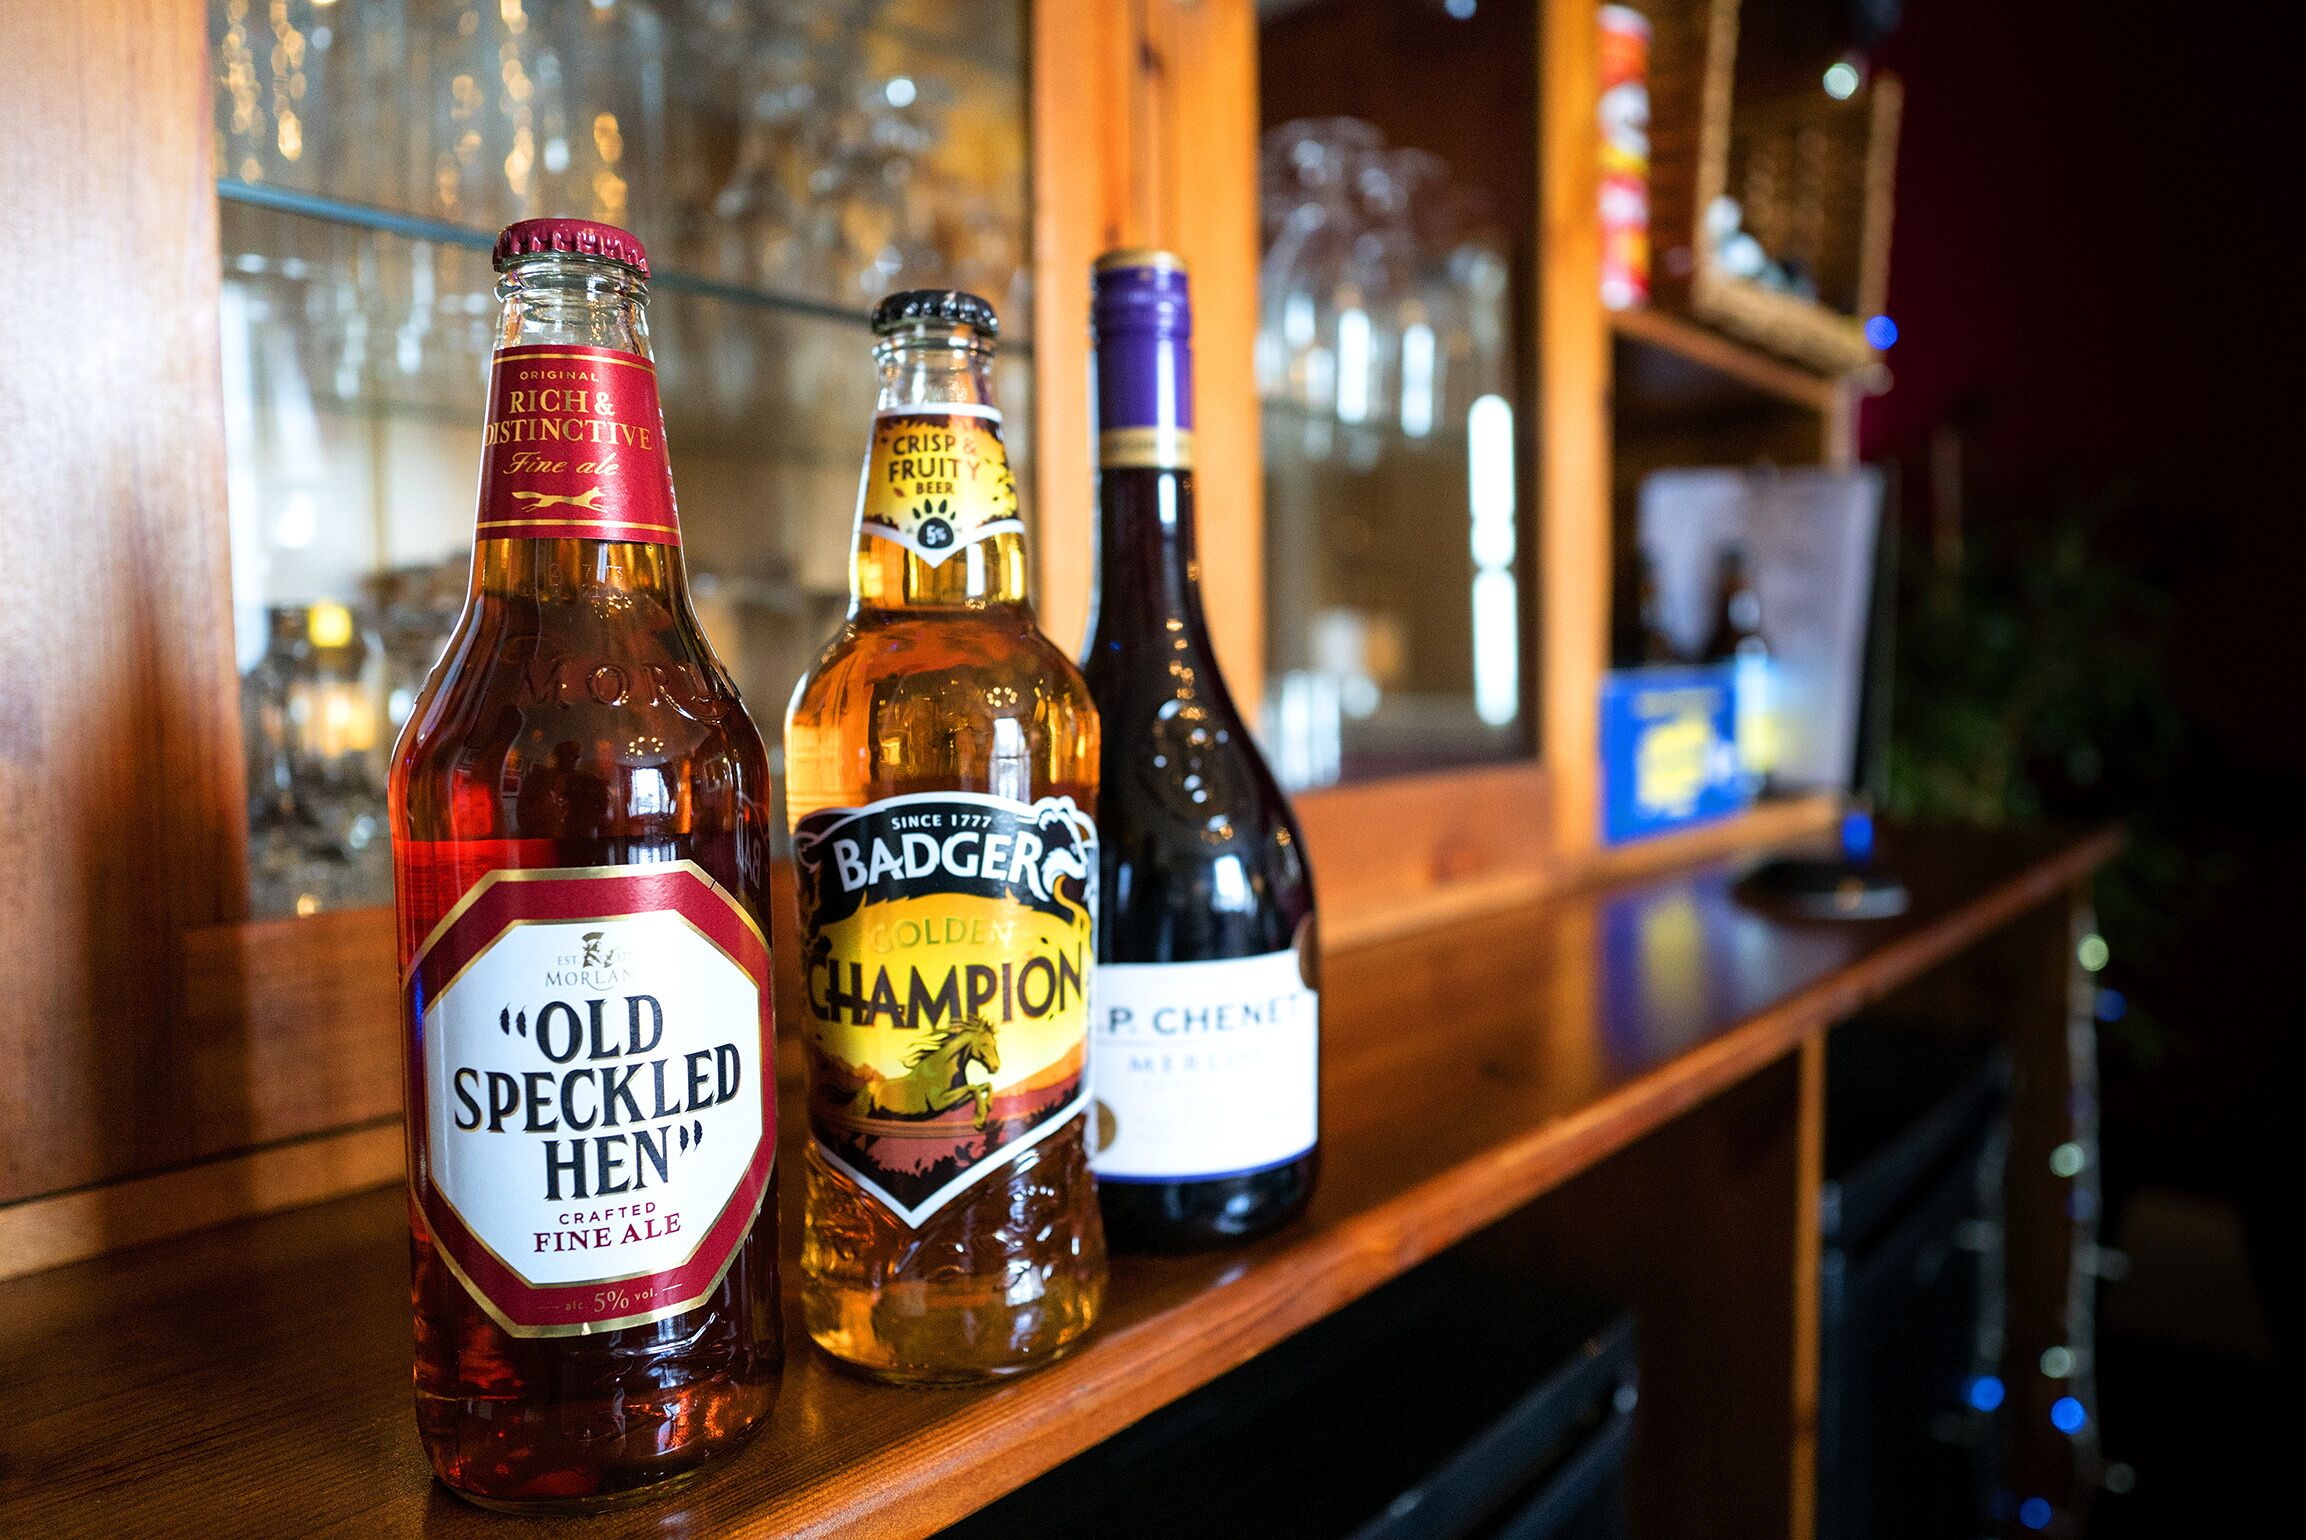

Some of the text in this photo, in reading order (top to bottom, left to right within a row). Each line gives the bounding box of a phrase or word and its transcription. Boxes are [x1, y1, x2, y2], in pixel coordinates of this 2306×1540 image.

[519, 370, 600, 383] ORIGINAL
[508, 388, 616, 417] RICH &
[485, 417, 653, 451] DISTINCTIVE
[892, 434, 957, 456] CRISP
[502, 450, 620, 477] Fine ale
[888, 457, 981, 484] FRUITY
[915, 481, 955, 496] BEER
[925, 524, 948, 546] 5%
[890, 814, 993, 831] SINCE 1777
[832, 831, 1050, 902] BADGER
[872, 916, 1016, 955] GOLDEN
[806, 939, 1084, 1029] CHAMPION
[453, 1042, 741, 1134] SPECKLED
[558, 1201, 657, 1226] CRAFTED
[533, 1212, 682, 1254] FINE ALE
[593, 1288, 631, 1314] 5%
[634, 1287, 659, 1301] vol.
